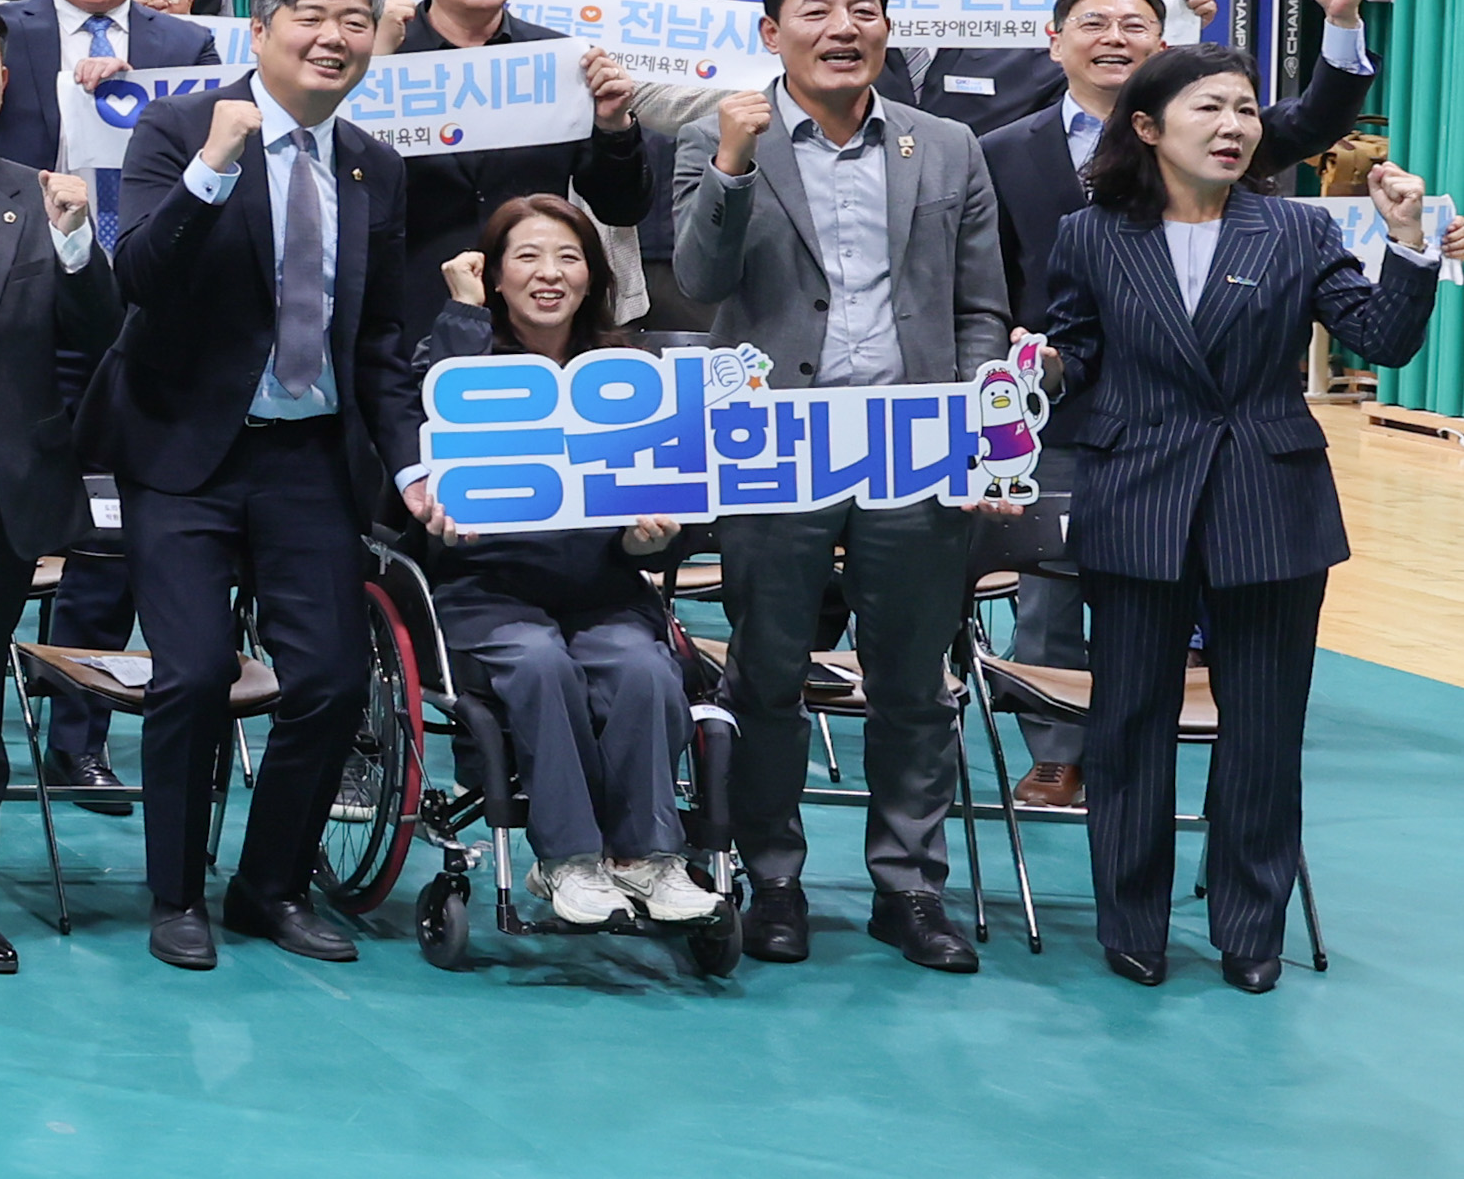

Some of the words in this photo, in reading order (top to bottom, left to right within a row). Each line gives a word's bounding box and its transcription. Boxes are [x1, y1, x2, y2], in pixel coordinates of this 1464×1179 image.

[620, 0, 764, 55] 전남시
[889, 18, 1037, 38] 남도장애인체육회
[346, 51, 558, 120] 전남시대
[430, 356, 979, 525] 응원합니다
